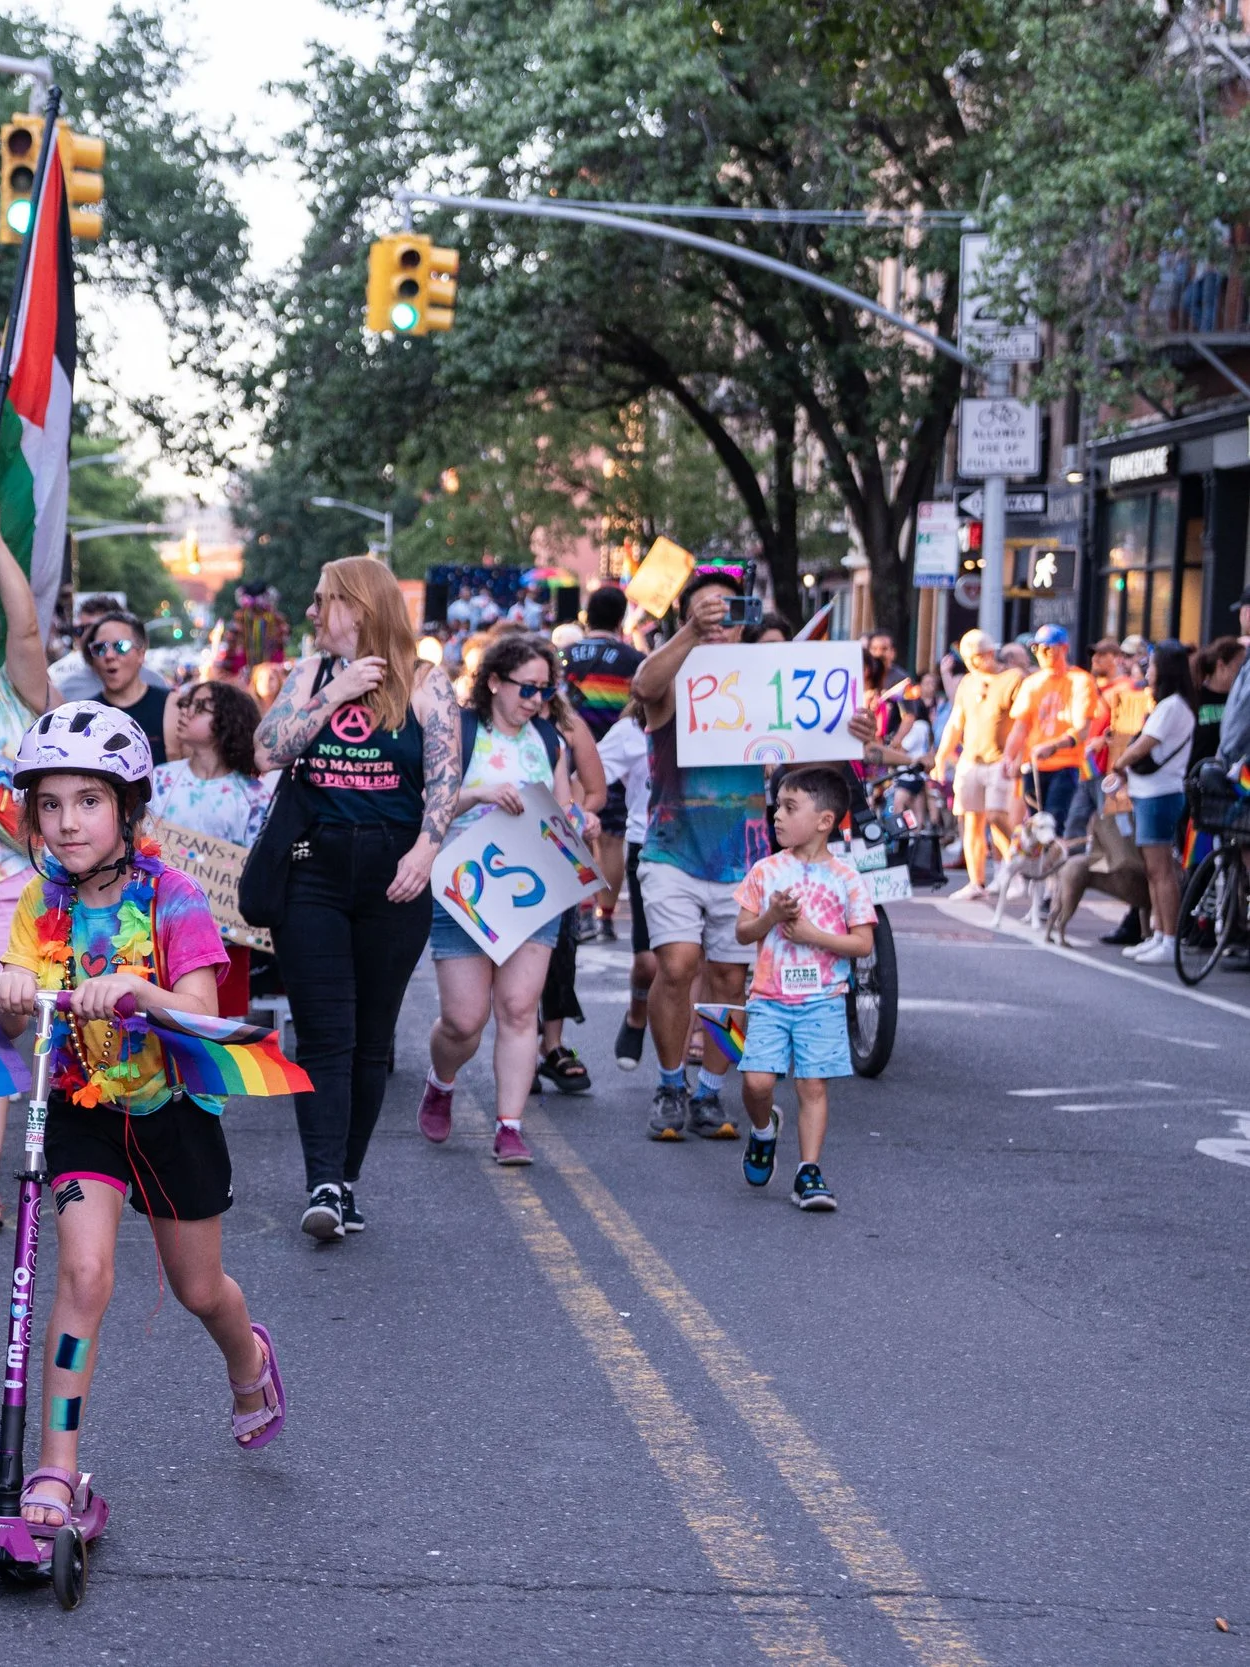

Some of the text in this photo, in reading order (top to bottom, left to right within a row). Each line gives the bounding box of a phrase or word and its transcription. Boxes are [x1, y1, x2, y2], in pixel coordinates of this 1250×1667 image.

[977, 442, 1020, 454] USE OF
[1006, 494, 1037, 511] WAY
[686, 669, 753, 735] P.S.
[318, 743, 381, 759] NO GOD
[329, 759, 394, 773] MASTER
[443, 841, 547, 945] PS
[784, 968, 818, 978] FREE
